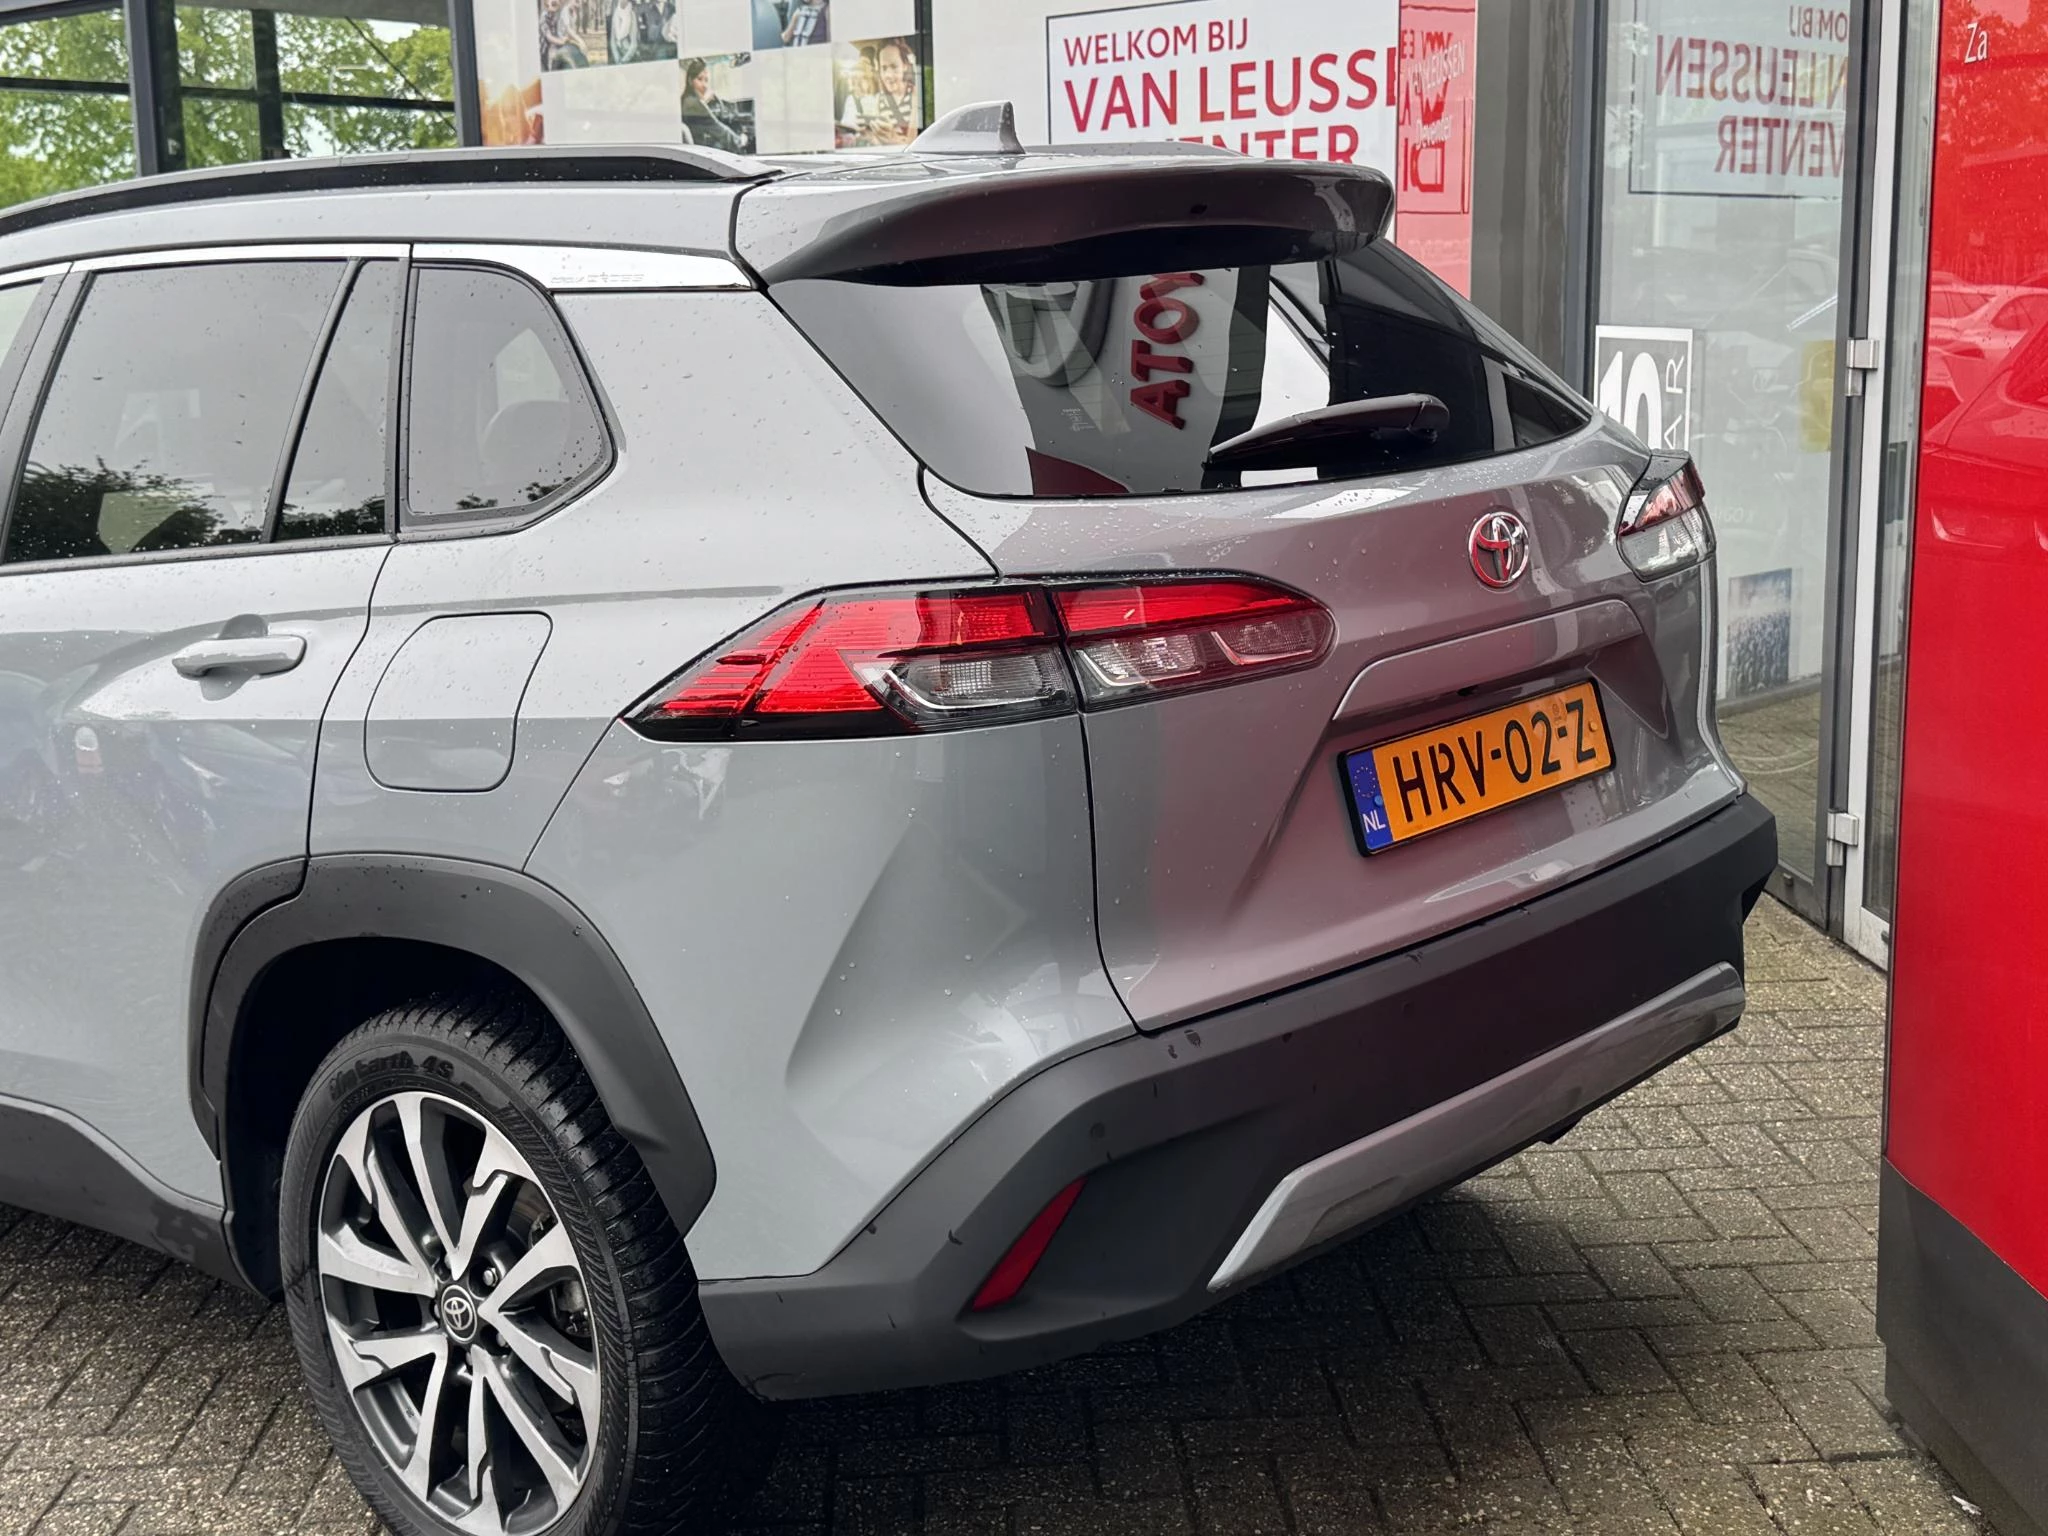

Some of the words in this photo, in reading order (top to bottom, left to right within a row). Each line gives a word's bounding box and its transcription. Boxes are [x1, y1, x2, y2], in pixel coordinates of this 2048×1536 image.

[1063, 23, 1197, 66] WELKOM
[1208, 18, 1249, 52] BIJ
[1963, 22, 1989, 64] Za
[1064, 70, 1178, 133] VAN
[1393, 699, 1597, 823] HRV-02-Z
[1362, 809, 1386, 833] NL
